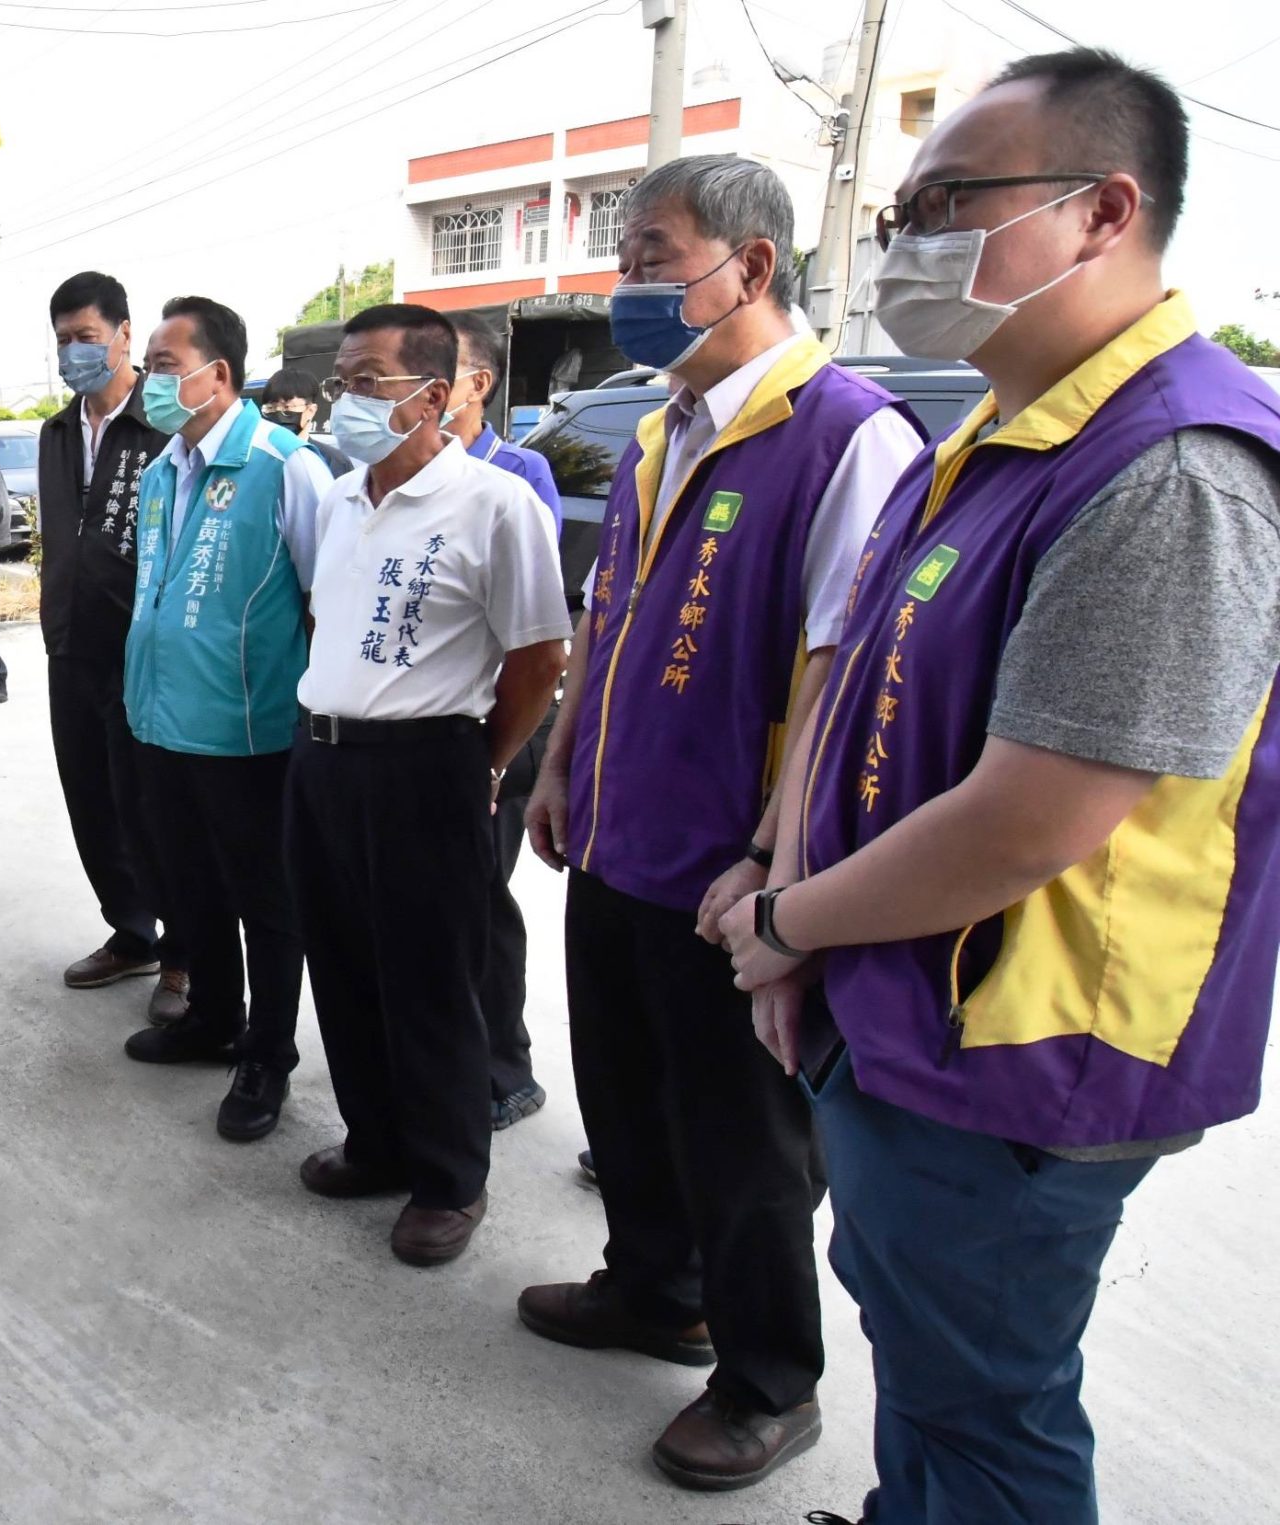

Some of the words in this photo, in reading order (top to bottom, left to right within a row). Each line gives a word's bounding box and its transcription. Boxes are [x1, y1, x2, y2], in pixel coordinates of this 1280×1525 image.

[360, 557, 405, 665] 張玉龍
[391, 533, 446, 668] 秀水鄉民代表
[660, 537, 718, 694] 秀水鄉公所
[858, 601, 915, 813] 秀水鄉公所
